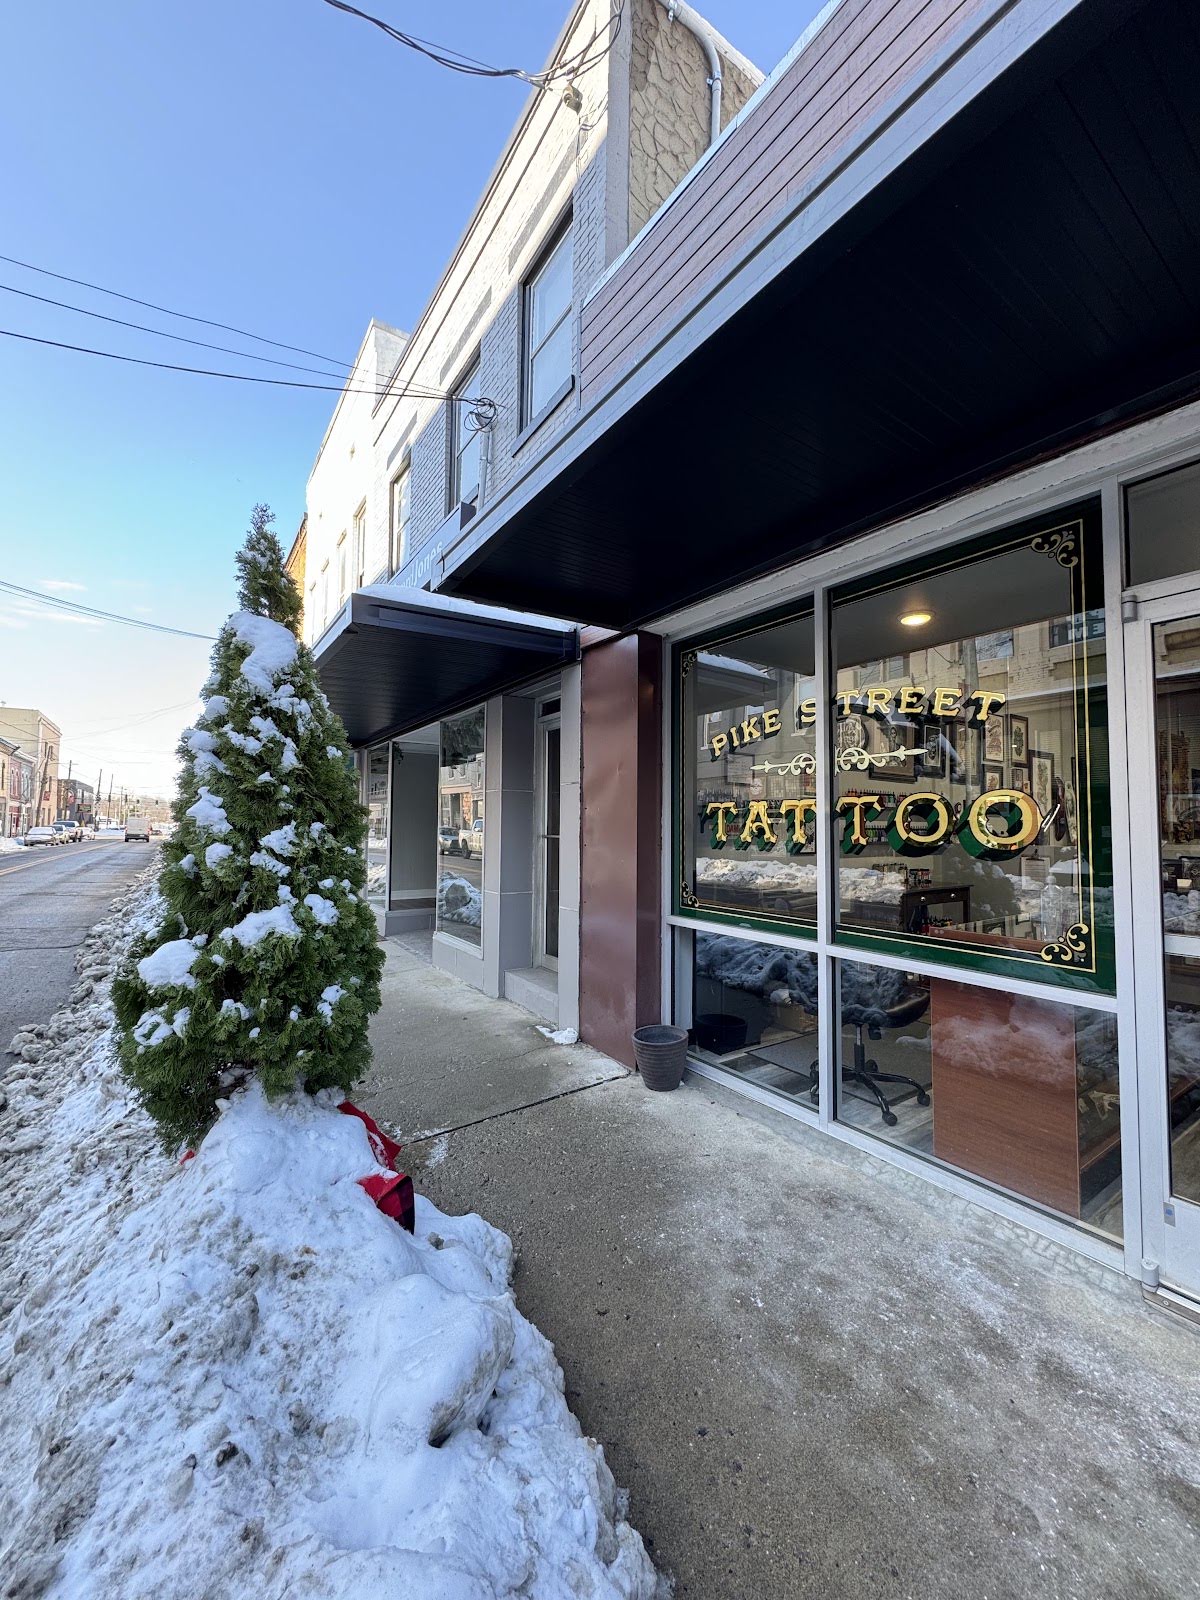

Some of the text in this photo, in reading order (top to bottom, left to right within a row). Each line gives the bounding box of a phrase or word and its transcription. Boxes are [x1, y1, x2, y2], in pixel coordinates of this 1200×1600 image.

[711, 687, 1006, 758] PIKE STREET
[705, 789, 1043, 854] TATTOO
